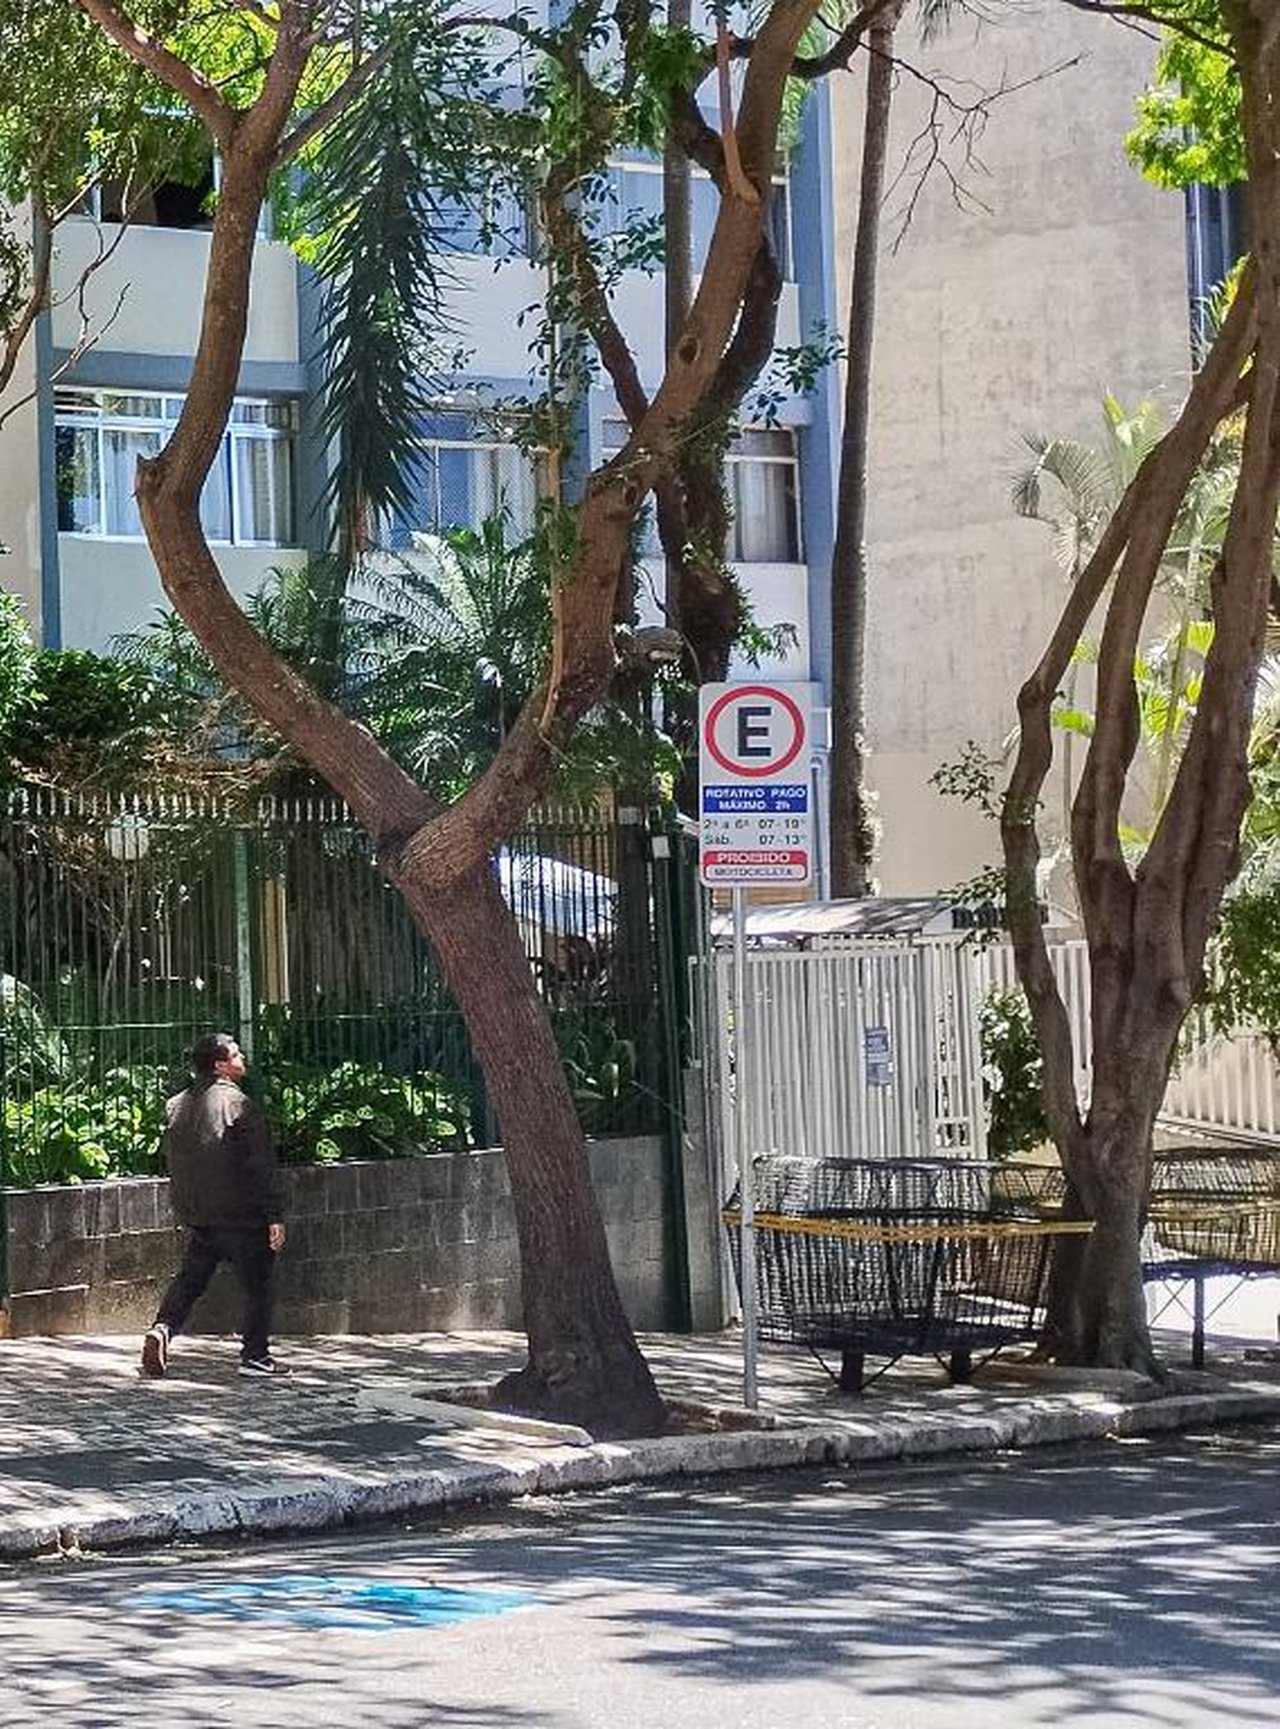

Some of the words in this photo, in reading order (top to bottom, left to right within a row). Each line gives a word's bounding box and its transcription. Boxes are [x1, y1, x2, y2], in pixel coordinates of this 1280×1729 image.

[737, 706, 772, 757] E
[705, 788, 766, 798] ROTATIVO
[771, 788, 806, 798] PAGO
[717, 852, 791, 863] PROIBIDO
